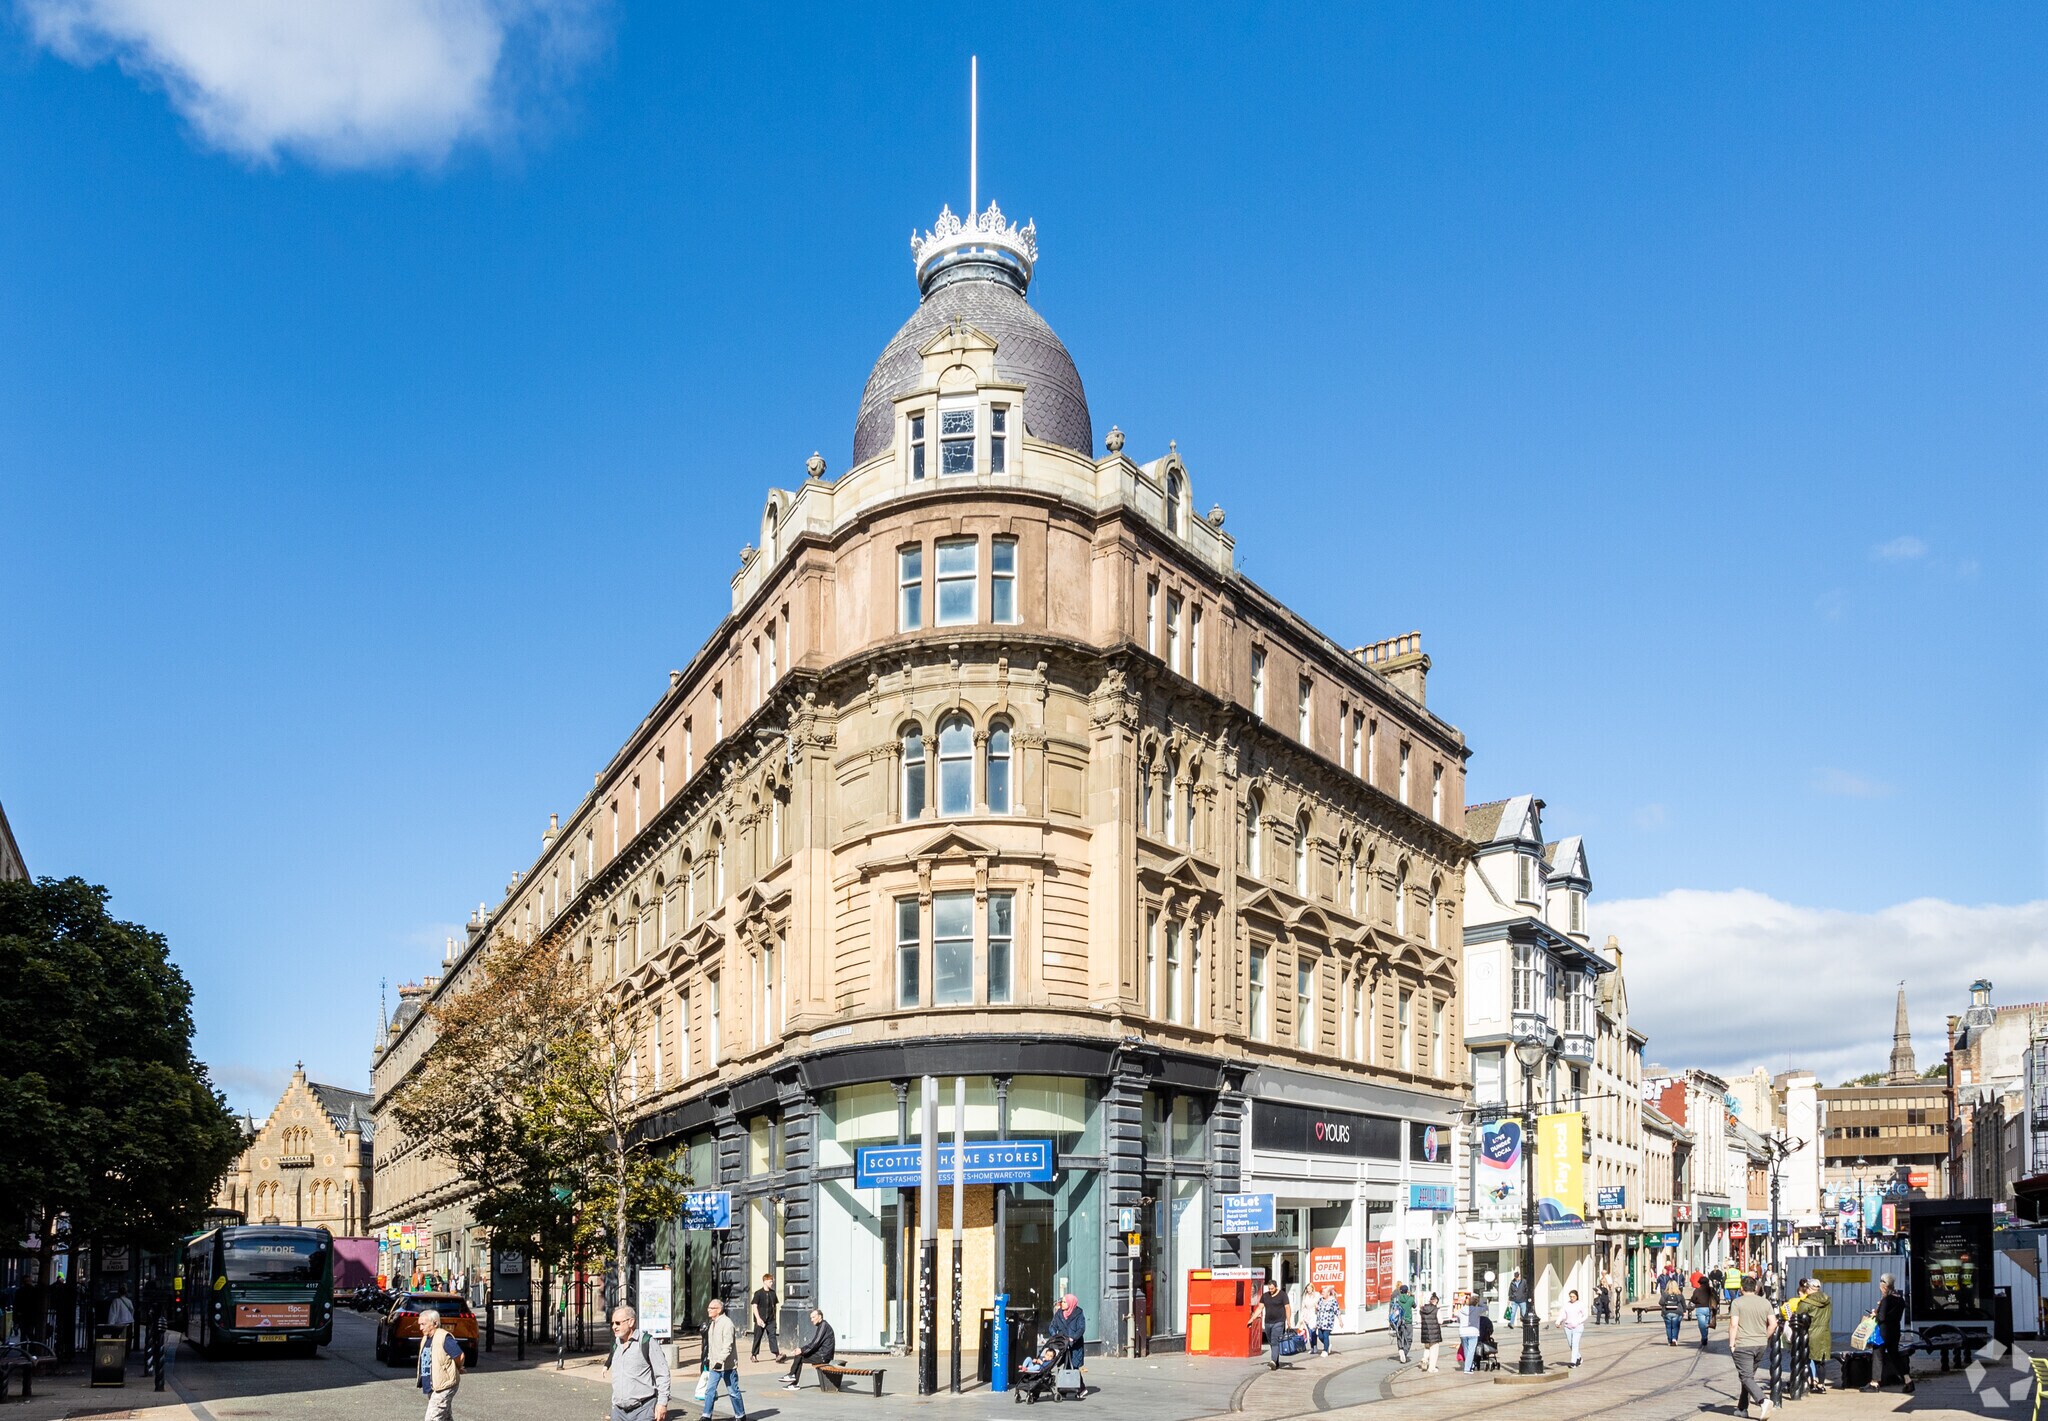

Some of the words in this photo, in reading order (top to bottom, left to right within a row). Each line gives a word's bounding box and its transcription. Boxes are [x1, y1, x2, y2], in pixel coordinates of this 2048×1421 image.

[1324, 1122, 1350, 1143] YOURS
[1553, 1122, 1568, 1158] local
[870, 1156, 922, 1168] SCOTTIS
[988, 1152, 1038, 1163] STORES
[1494, 1146, 1512, 1158] LOCAL
[1553, 1161, 1572, 1193] Play
[1317, 1263, 1339, 1271] OPEN
[1314, 1272, 1343, 1281] ONLINE
